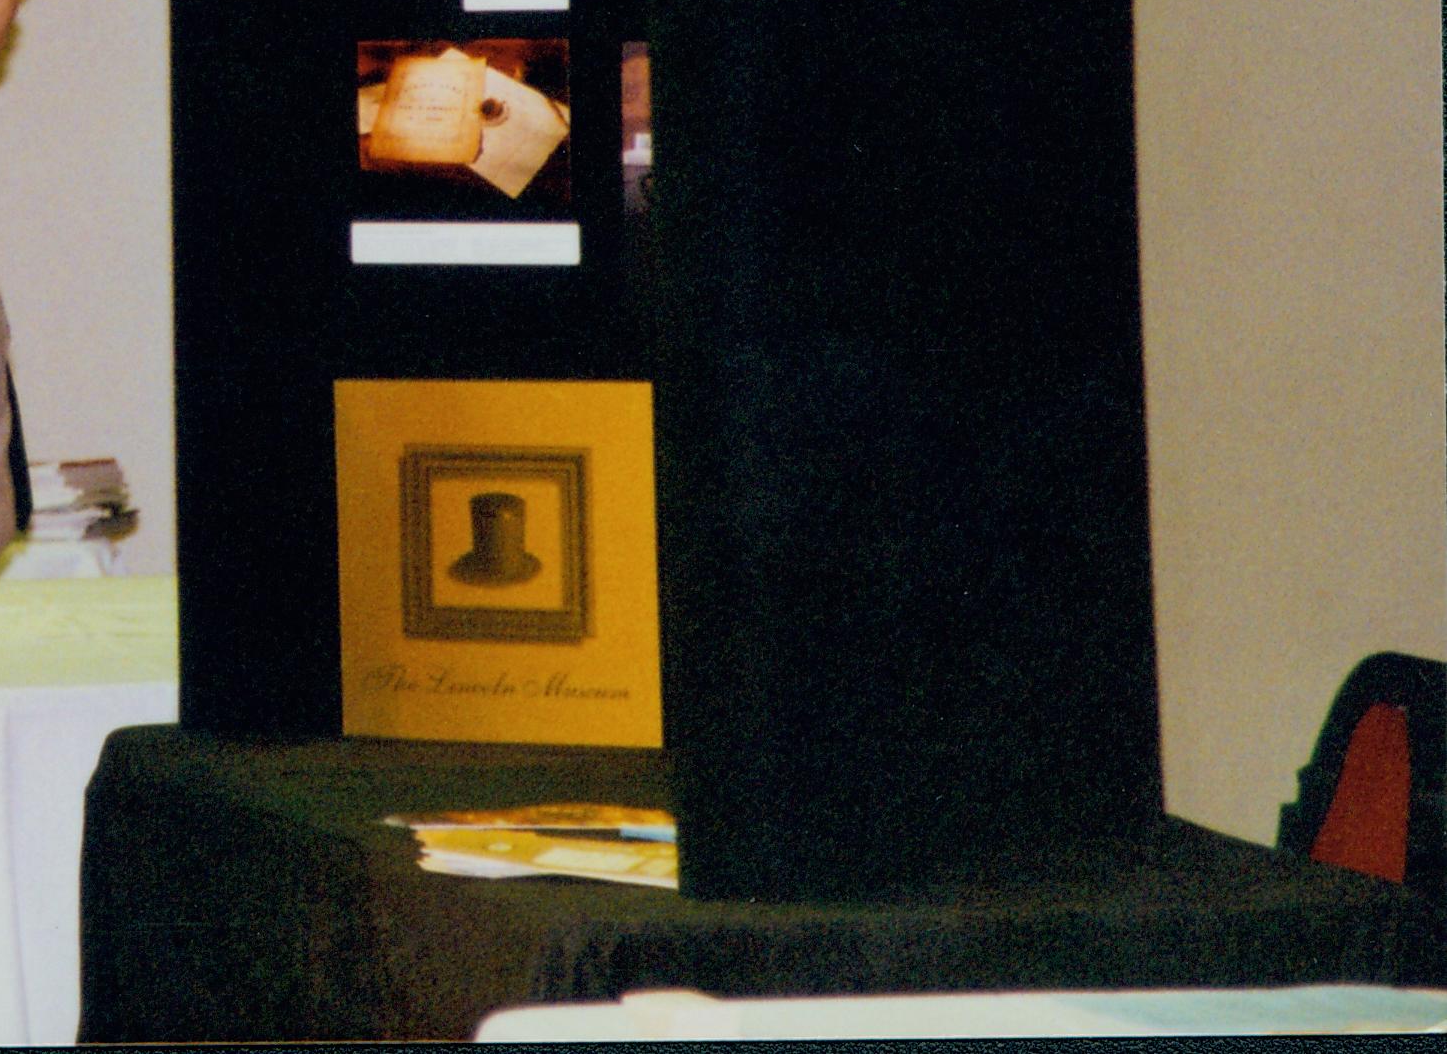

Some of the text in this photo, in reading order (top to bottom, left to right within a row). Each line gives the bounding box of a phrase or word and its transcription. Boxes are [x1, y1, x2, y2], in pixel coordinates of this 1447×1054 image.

[362, 661, 630, 700] The Lincoln Museum
